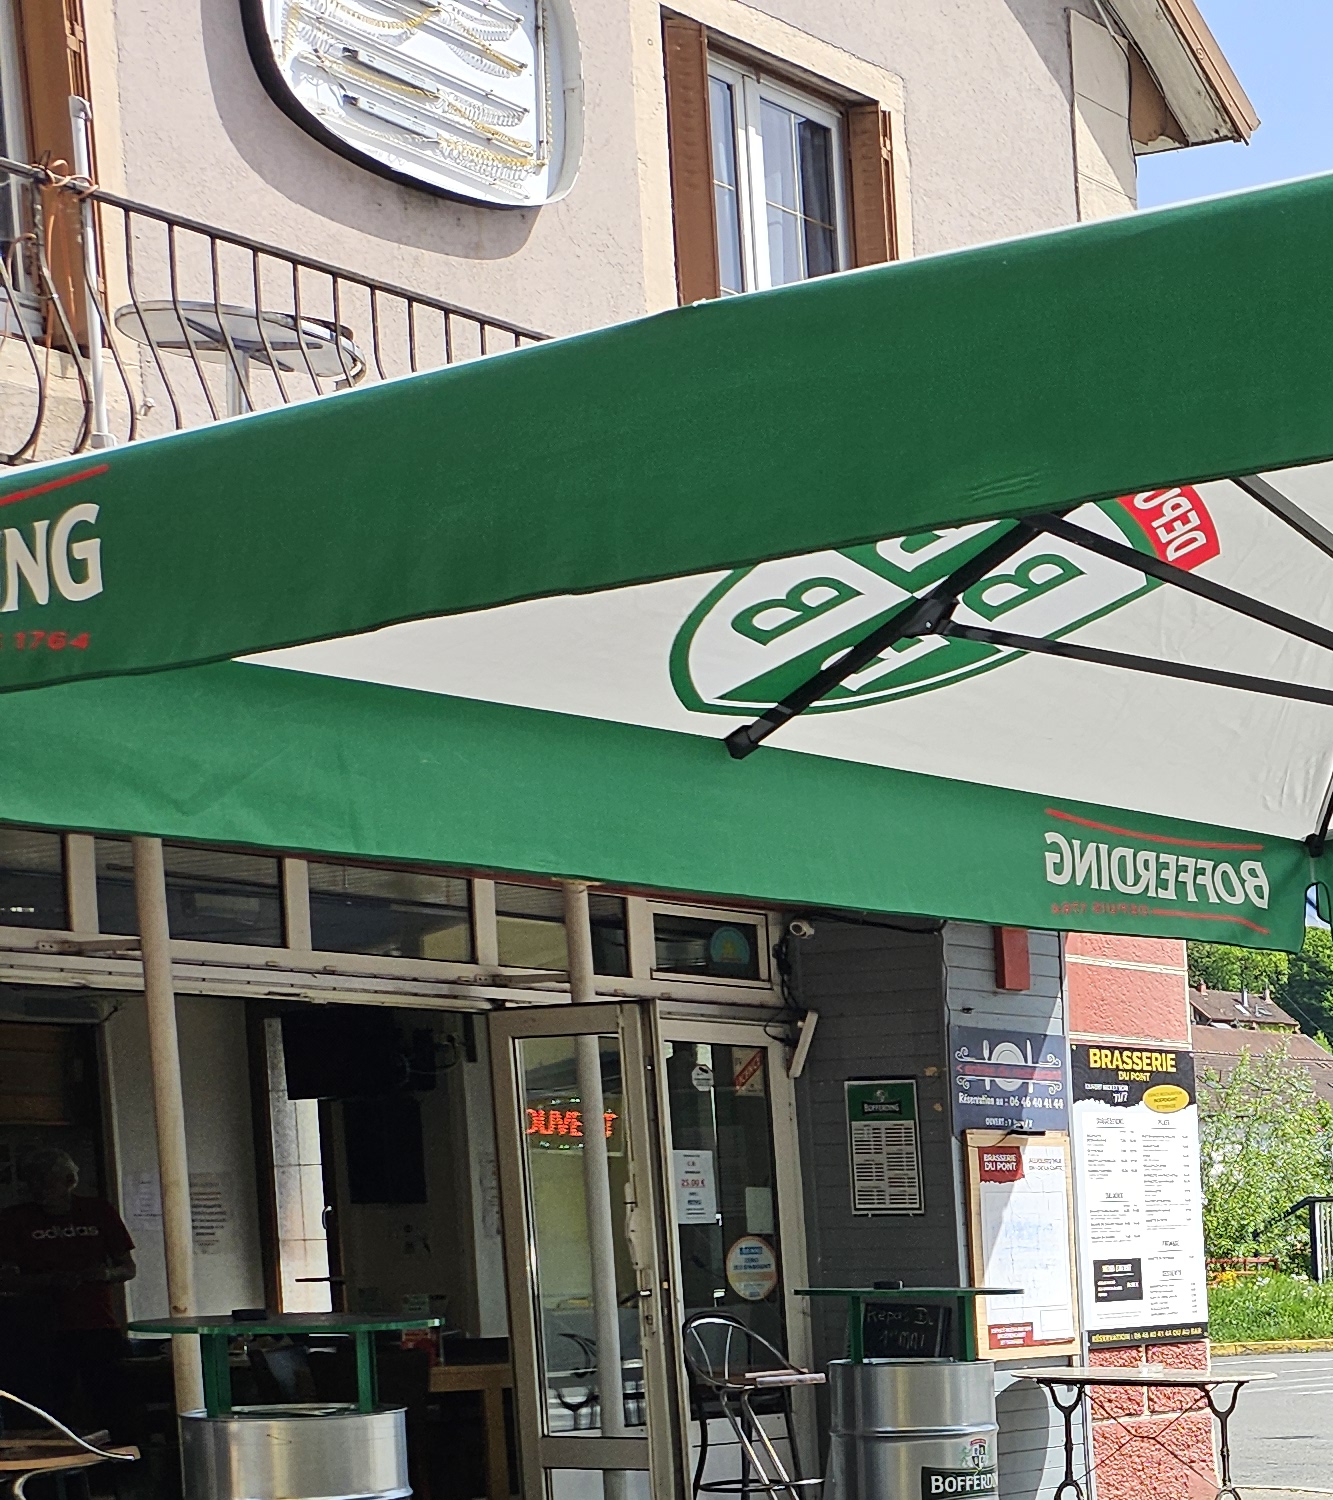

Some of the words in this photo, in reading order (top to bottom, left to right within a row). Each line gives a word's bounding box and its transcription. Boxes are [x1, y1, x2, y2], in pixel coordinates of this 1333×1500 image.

[14, 631, 90, 650] 1764
[1089, 1048, 1177, 1073] BRASSERIE
[1118, 1071, 1130, 1080] DU
[1131, 1072, 1151, 1081] PONT
[959, 1092, 995, 1106] Réservation
[1010, 1096, 1020, 1107] 06
[525, 1109, 619, 1139] OUVET
[984, 1154, 1017, 1162] BRASSERIE
[985, 1162, 996, 1170] DU
[997, 1162, 1017, 1171] PONT
[31, 1223, 99, 1239] adidas
